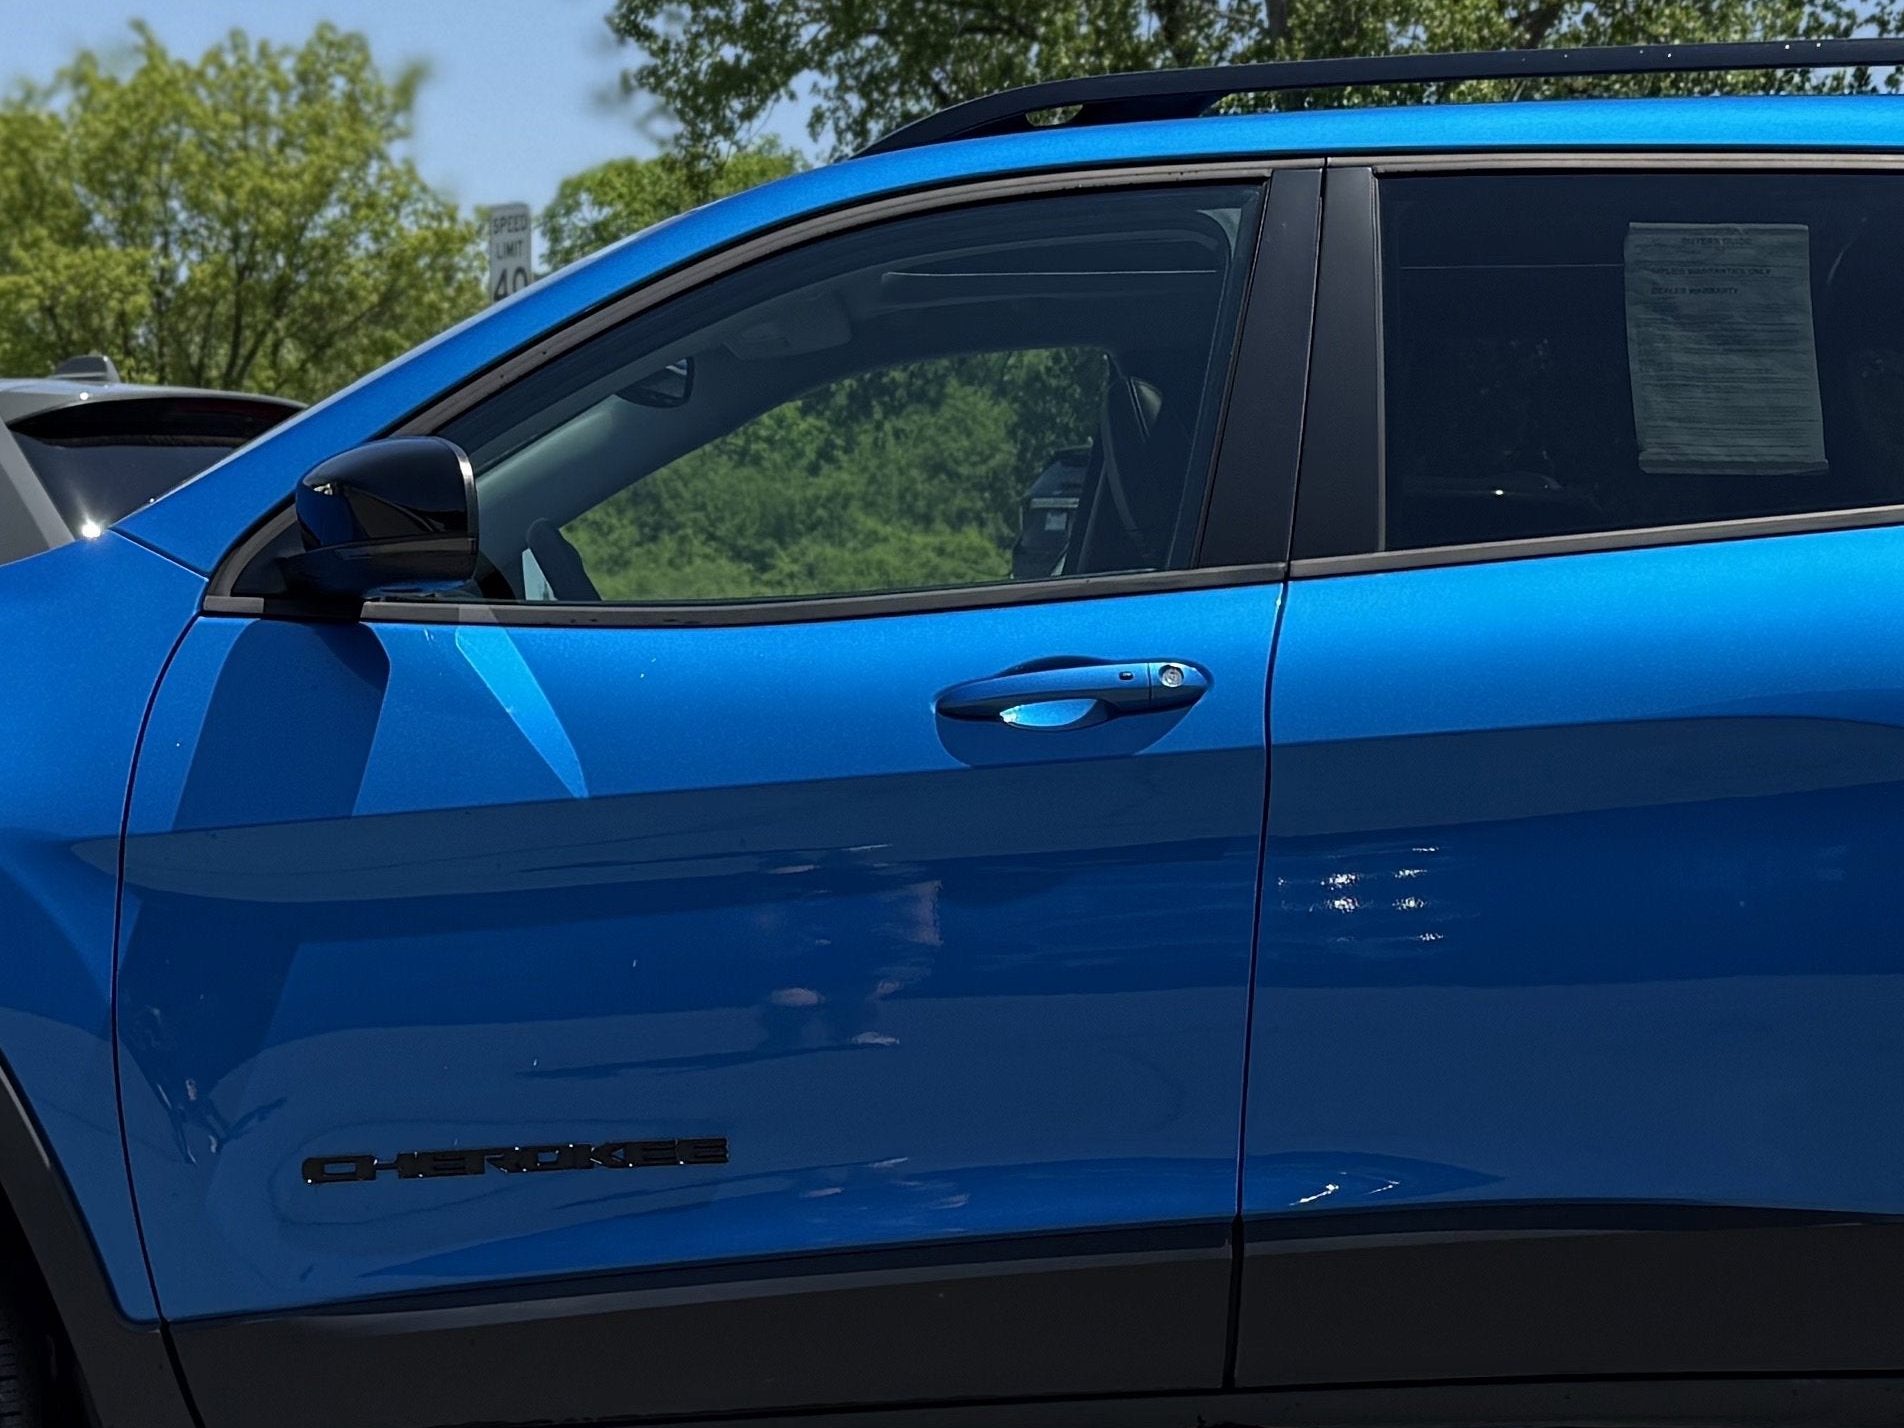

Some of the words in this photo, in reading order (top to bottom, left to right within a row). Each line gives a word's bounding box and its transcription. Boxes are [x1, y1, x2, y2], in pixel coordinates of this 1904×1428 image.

[493, 215, 528, 234] SPEED
[497, 239, 523, 259] LIMIT
[301, 1136, 730, 1185] CHEROKEE
